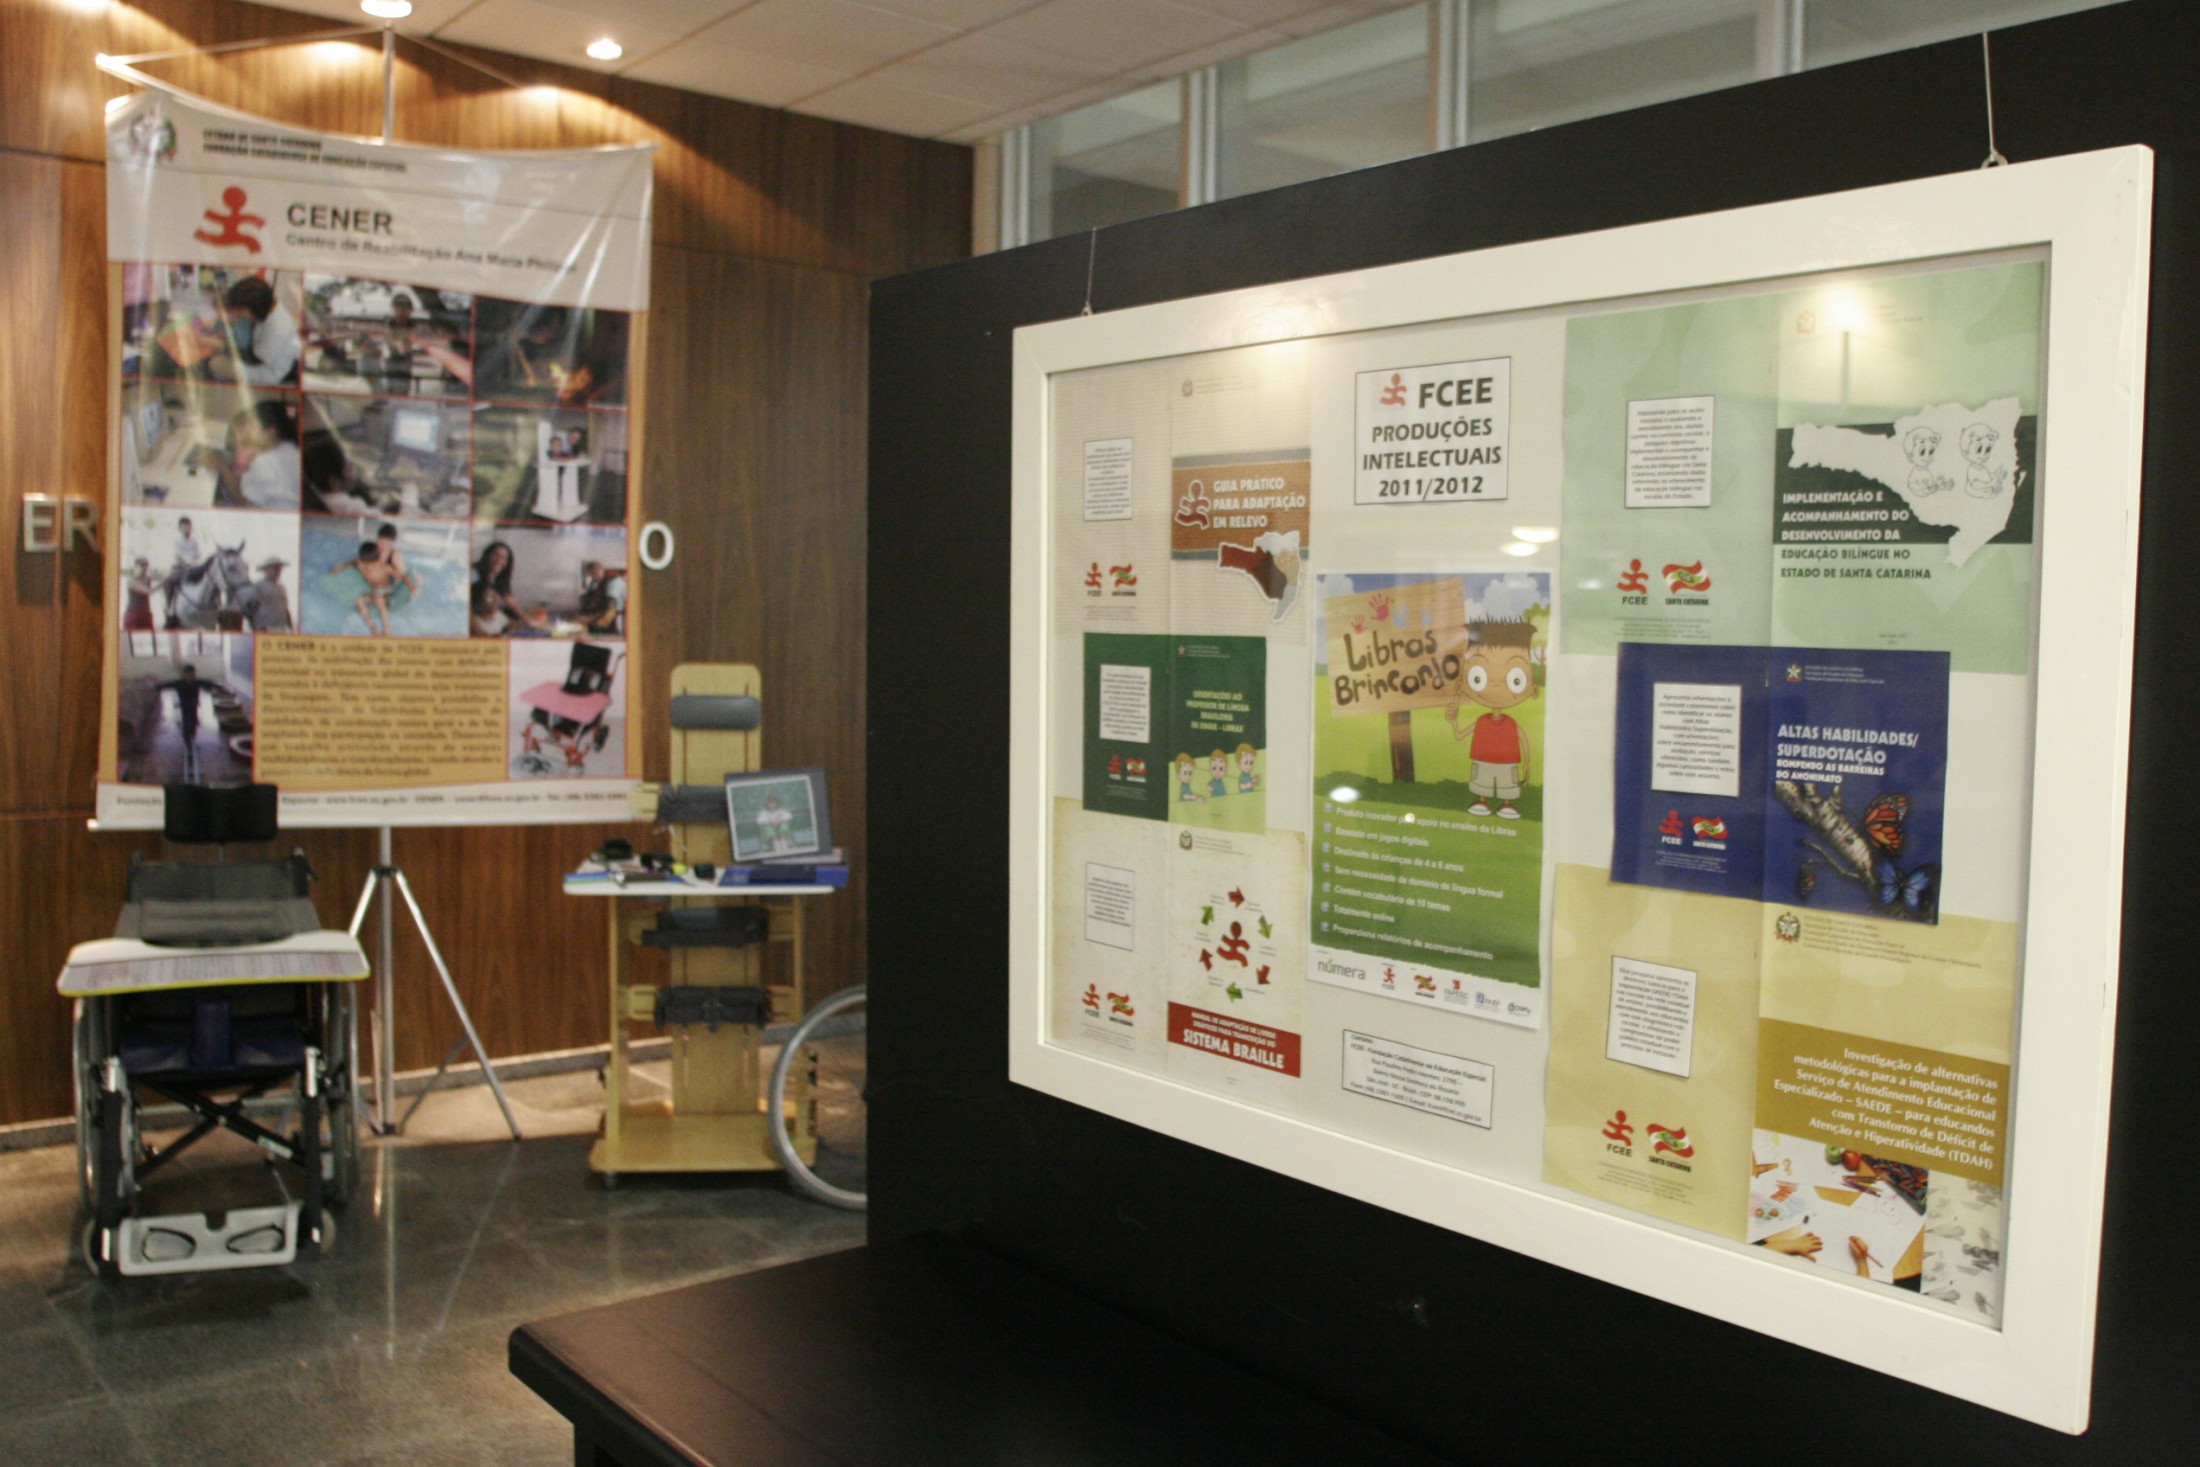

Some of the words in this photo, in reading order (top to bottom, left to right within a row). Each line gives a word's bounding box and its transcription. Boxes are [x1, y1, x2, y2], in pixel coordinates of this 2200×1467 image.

[287, 203, 392, 234] CENER
[1419, 377, 1494, 409] FCEE
[1372, 416, 1492, 443] PRODUÇÕES
[1363, 446, 1502, 470] INTELECTUAIS
[1213, 480, 1238, 492] GUIA
[1240, 476, 1285, 491] PRÁTICO
[1378, 476, 1484, 501] 2011/2012
[1213, 498, 1240, 510] PARA
[1242, 492, 1306, 512] ADAPTAÇÃO
[1783, 490, 1874, 505] IMPLEMENTAÇÃO
[1876, 490, 1884, 502] E
[1213, 516, 1227, 528] EM
[1229, 515, 1268, 528] RELEVO
[1782, 510, 1888, 522] ACOMPANHAMENTO
[1892, 510, 1910, 521] DO
[1782, 530, 1882, 540] DESENVOLVIMENTO
[1884, 530, 1900, 540] DA
[1782, 546, 1838, 562] EDUCAÇÃO
[1842, 547, 1890, 559] BILÍNGUE
[1894, 549, 1910, 559] NO
[1781, 568, 1820, 578] ESTADO
[1824, 568, 1836, 578] DE
[1840, 569, 1872, 578] SANTA
[1876, 569, 1931, 579] CATARINA
[1622, 596, 1648, 606] FCEE
[1778, 724, 1819, 740] ALTAS
[1822, 728, 1918, 748] HABILIDADES/
[1777, 743, 1886, 765] SUPERDOTAÇÃO
[1776, 759, 1824, 770] ROMPENDO
[1825, 763, 1836, 771] AS
[1838, 764, 1884, 776] BARREIRAS
[1776, 770, 1790, 778] DO
[1791, 771, 1842, 784] ANONIMATO
[1317, 959, 1365, 980] númera
[1183, 1029, 1230, 1054] SISTEMA
[1233, 1042, 1284, 1069] BRAILLE
[1793, 1054, 1869, 1078] metodológicas
[1872, 1072, 1896, 1085] para
[1900, 1078, 1906, 1086] a
[1909, 1078, 1979, 1102] implantação
[1982, 1091, 1997, 1105] de
[1844, 1048, 1911, 1071] Investigação
[1914, 1063, 1928, 1074] de
[1931, 1066, 1998, 1089] alternativas
[1796, 1069, 1835, 1088] Serviço
[1837, 1078, 1850, 1090] de
[1852, 1081, 1924, 1105] Atendimento
[1926, 1098, 1996, 1121] Educacional
[1774, 1079, 1842, 1102] Especializado
[1855, 1097, 1892, 1114] SAEDE
[1905, 1111, 1932, 1124] para
[1933, 1116, 1995, 1138] educandos
[1831, 1110, 1855, 1121] com
[1858, 1112, 1917, 1135] Transtorno
[1920, 1127, 1934, 1140] de
[1937, 1130, 1977, 1149] Déficit
[1979, 1142, 1994, 1154] de
[1606, 1144, 1632, 1157] FCEE
[1809, 1118, 1852, 1136] Atenção
[1854, 1130, 1861, 1138] e
[1864, 1129, 1946, 1158] Hiperatividade
[1948, 1150, 1993, 1170] (TDAH)
